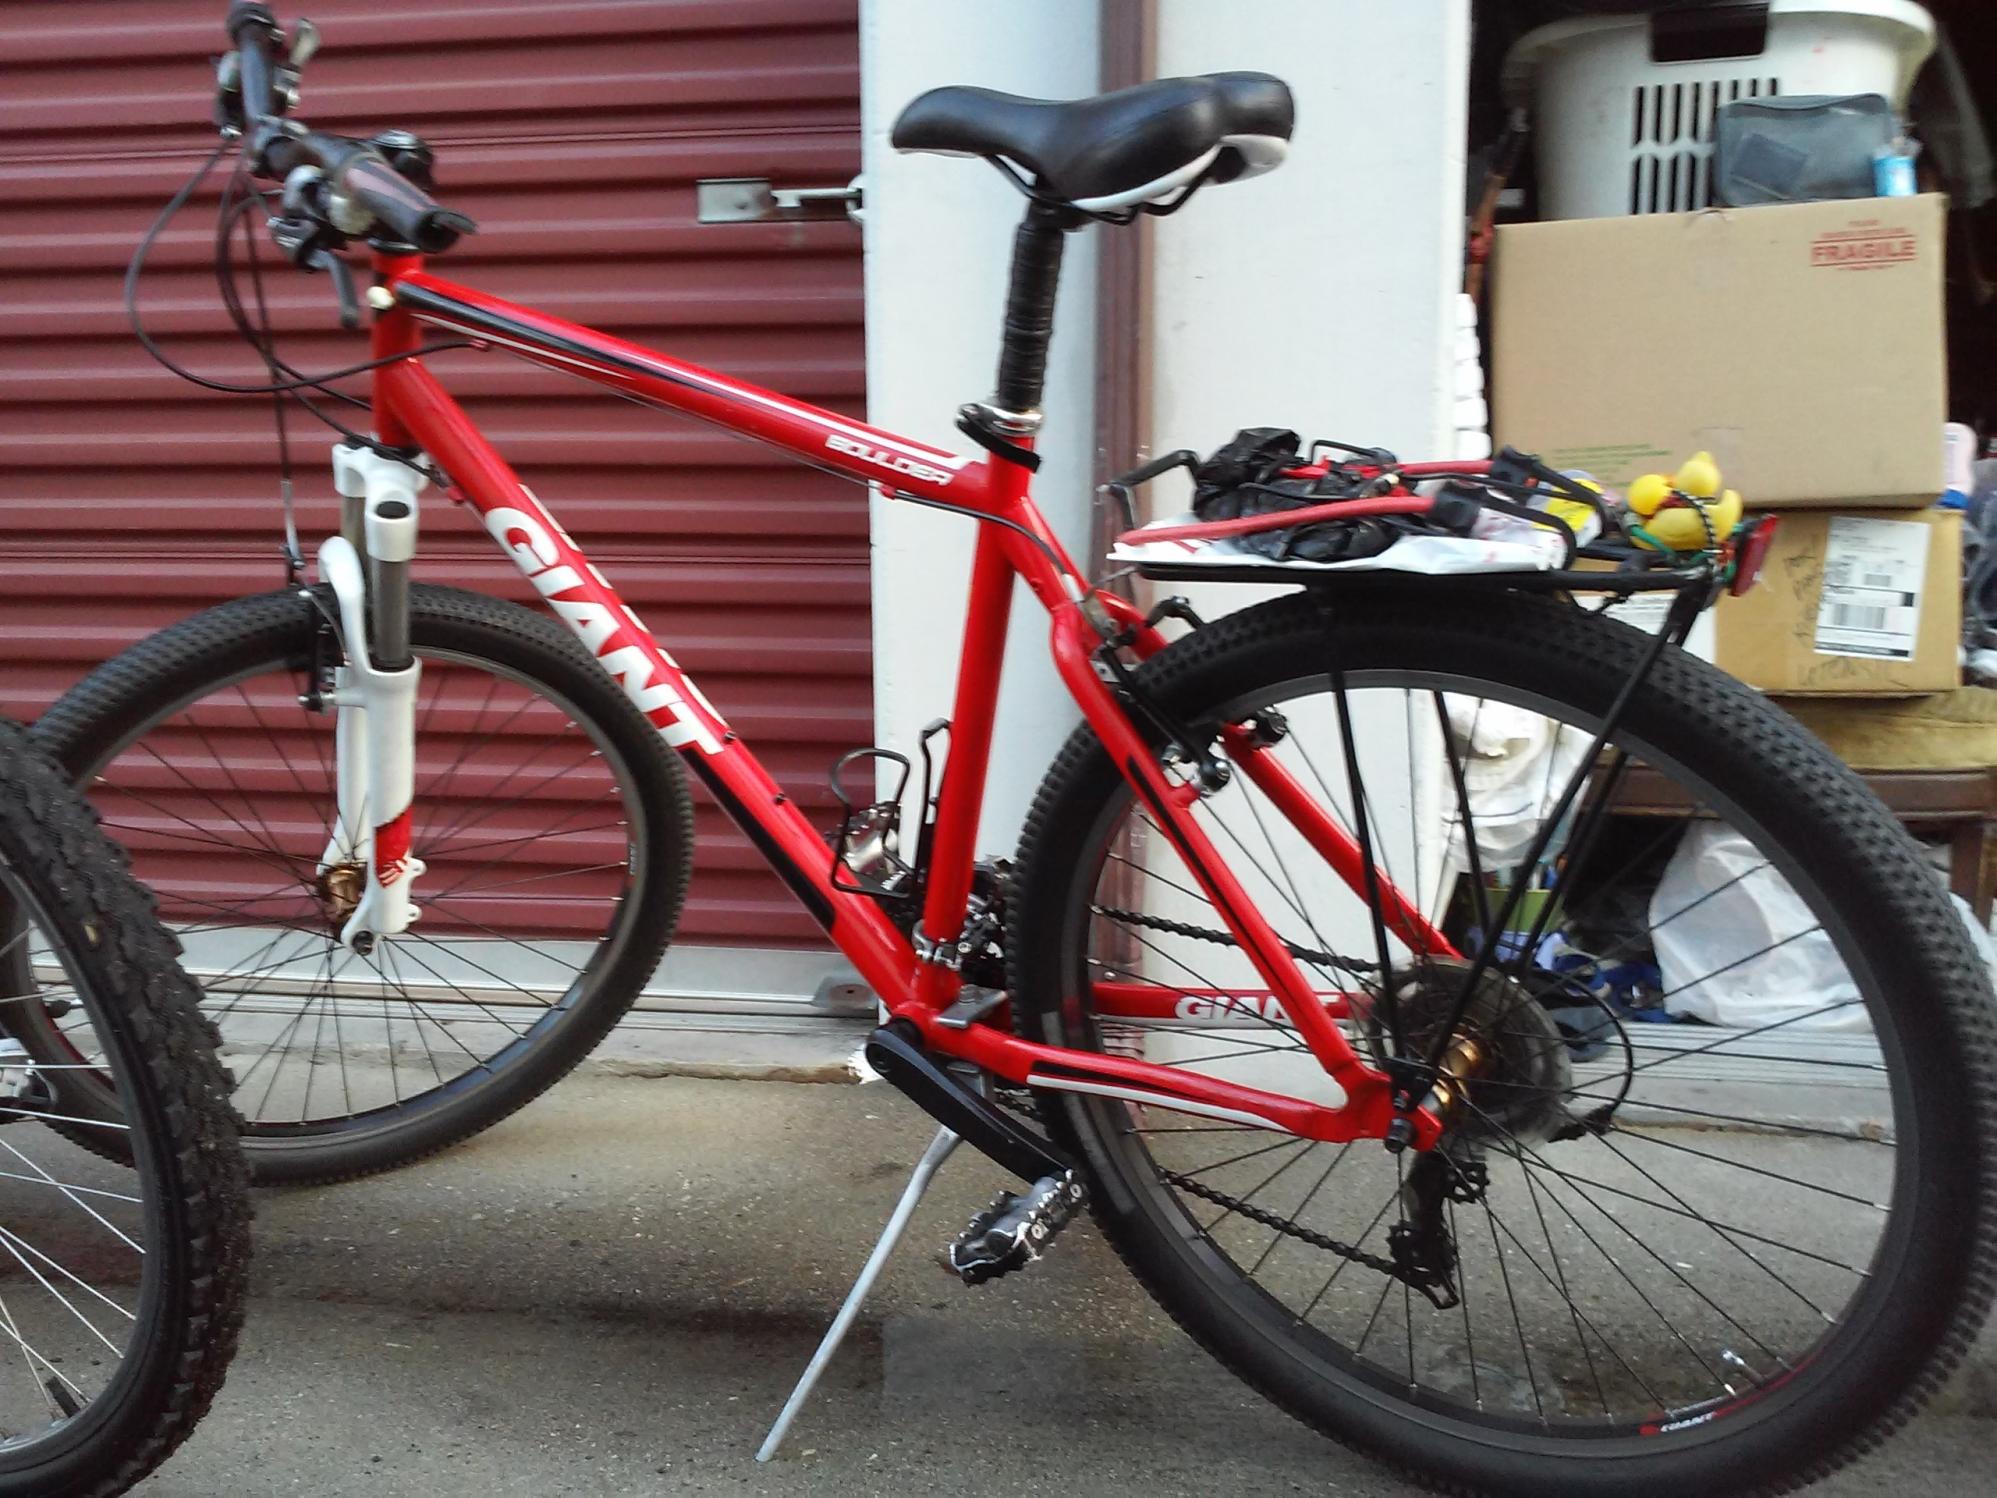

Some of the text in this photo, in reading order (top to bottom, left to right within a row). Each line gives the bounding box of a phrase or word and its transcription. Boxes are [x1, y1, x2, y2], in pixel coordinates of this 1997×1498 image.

[1811, 240, 1917, 262] FRAGILE
[825, 434, 955, 486] BOULDER
[484, 507, 725, 755] GIANT
